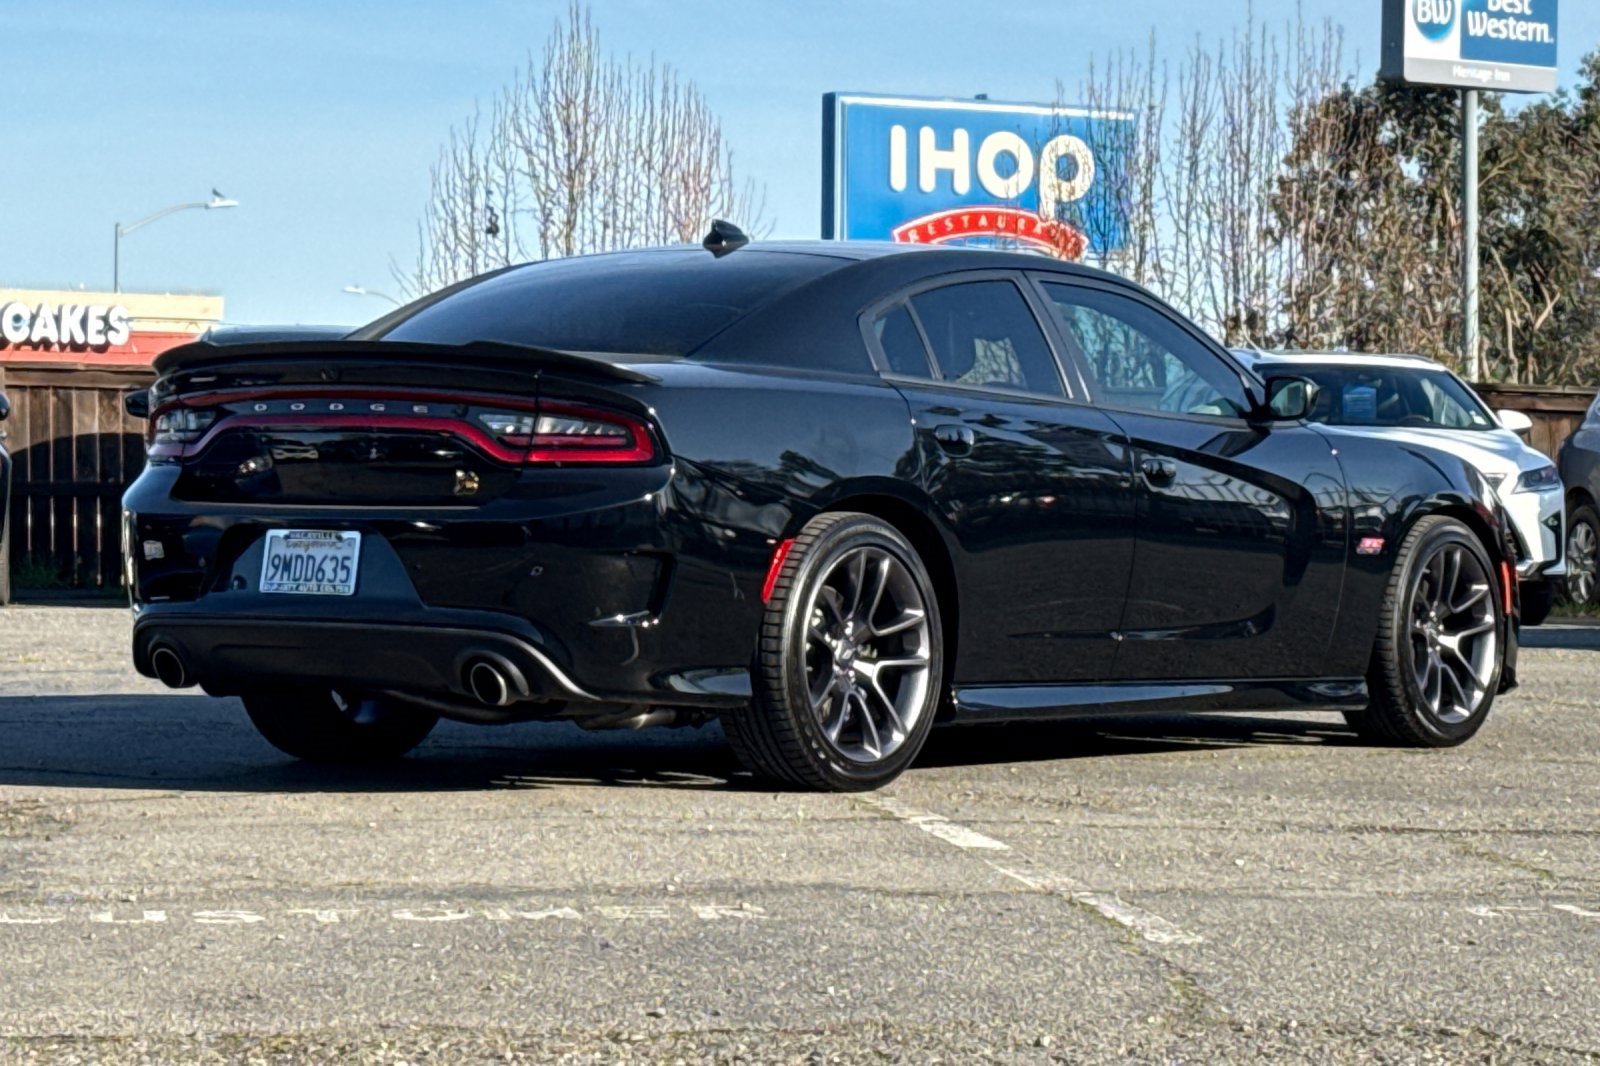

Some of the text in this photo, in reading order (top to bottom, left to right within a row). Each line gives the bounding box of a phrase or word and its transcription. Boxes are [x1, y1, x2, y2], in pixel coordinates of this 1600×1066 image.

[1416, 0, 1452, 25] BW
[254, 403, 428, 414] DODGE
[267, 553, 352, 583] 9MDD635
